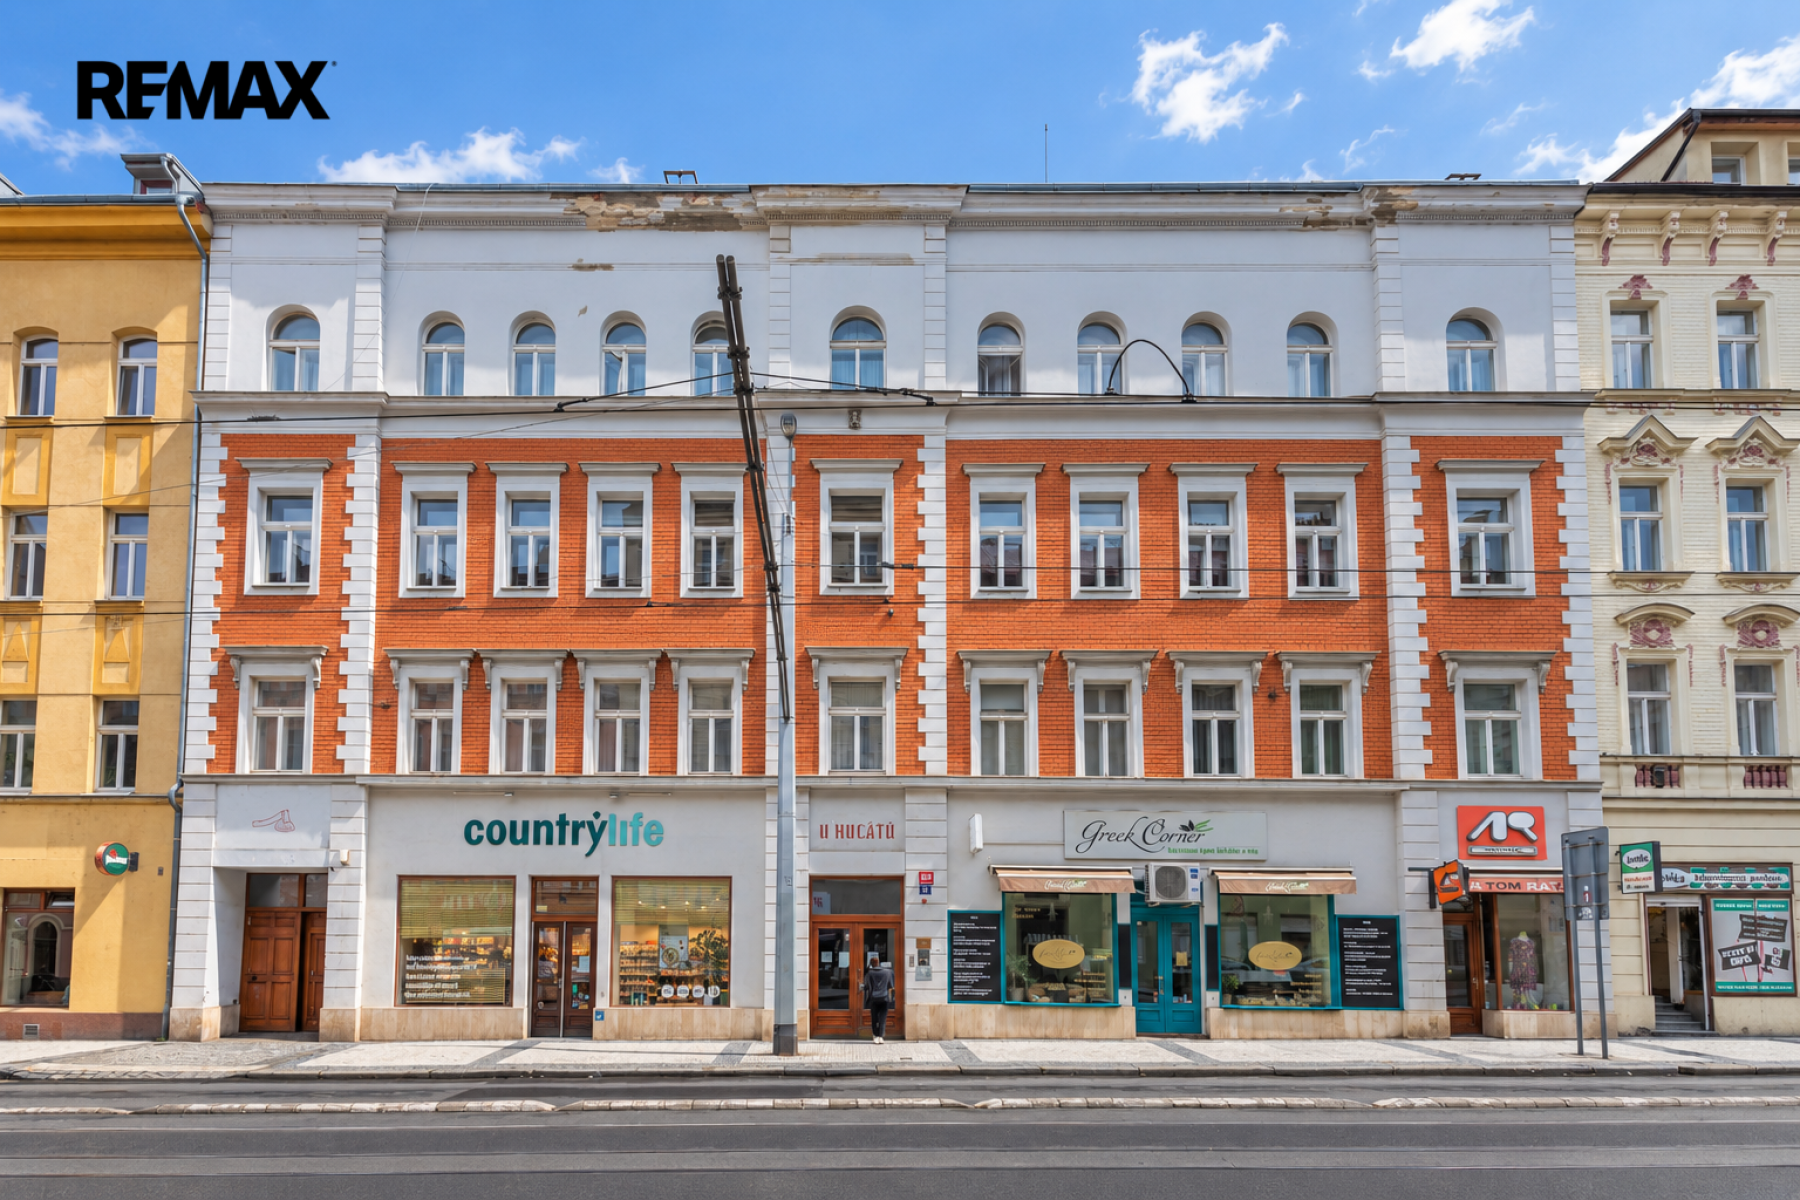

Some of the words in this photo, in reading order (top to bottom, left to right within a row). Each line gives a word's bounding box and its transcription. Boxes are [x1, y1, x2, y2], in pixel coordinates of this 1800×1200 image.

[819, 824, 829, 840] U
[1075, 816, 1160, 853] Greek
[1142, 818, 1206, 846] Corner
[1485, 881, 1521, 891] TOM
